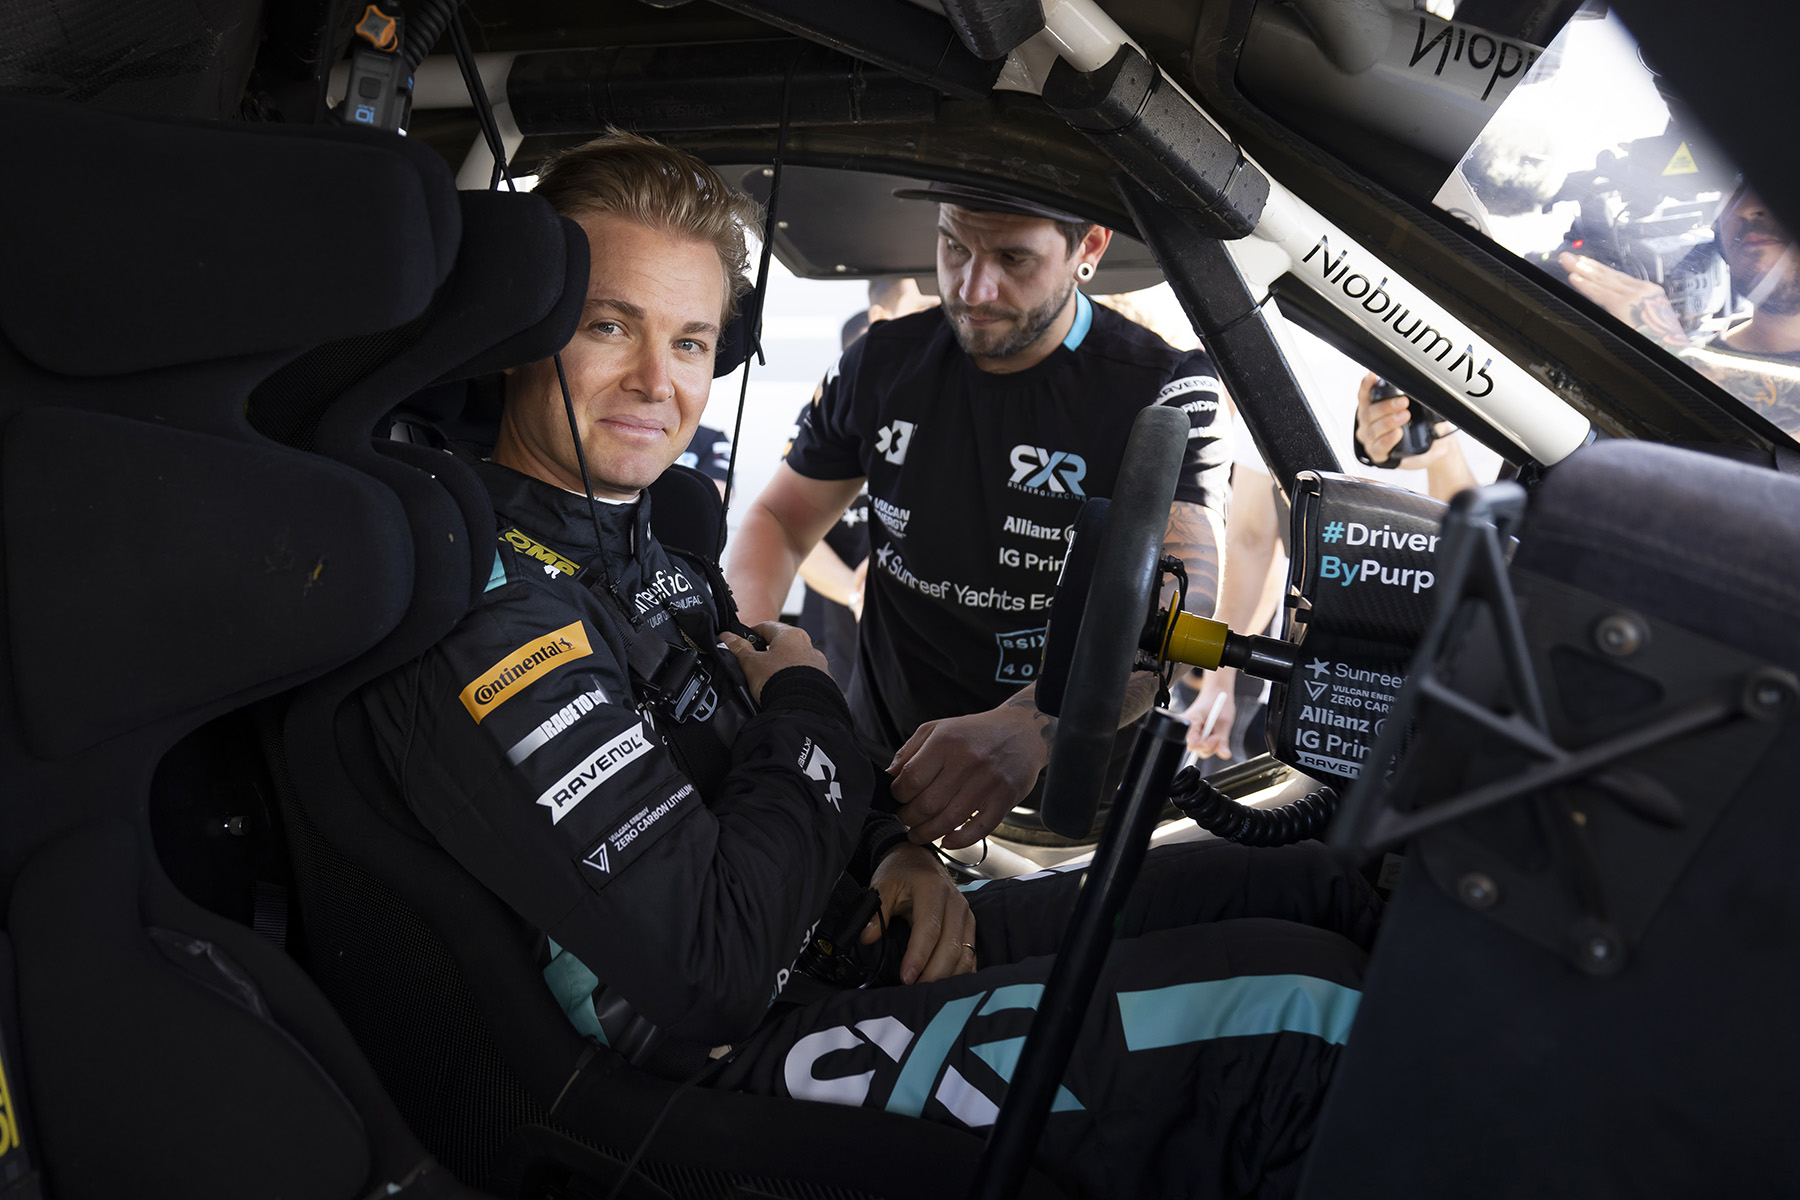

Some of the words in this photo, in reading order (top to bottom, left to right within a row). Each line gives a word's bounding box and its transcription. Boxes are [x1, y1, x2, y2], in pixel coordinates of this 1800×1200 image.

[874, 497, 910, 521] VULCAN
[1003, 515, 1061, 540] Allianz
[504, 529, 577, 577] OMP
[999, 547, 1020, 567] IG
[888, 555, 951, 599] Sunreef
[954, 583, 1025, 611] Yachts
[1320, 555, 1435, 594] ByPurp
[474, 641, 563, 705] Continental
[1330, 693, 1362, 708] ZERO
[1364, 700, 1391, 714] CAR
[1332, 684, 1370, 698] VULCAN
[540, 703, 580, 739] RACE
[573, 692, 594, 717] TO
[1299, 704, 1370, 733] Allianz
[1295, 728, 1320, 749] IG
[552, 737, 643, 808] RAVENOL
[613, 828, 639, 852] ZERO
[636, 802, 670, 832] CARBON
